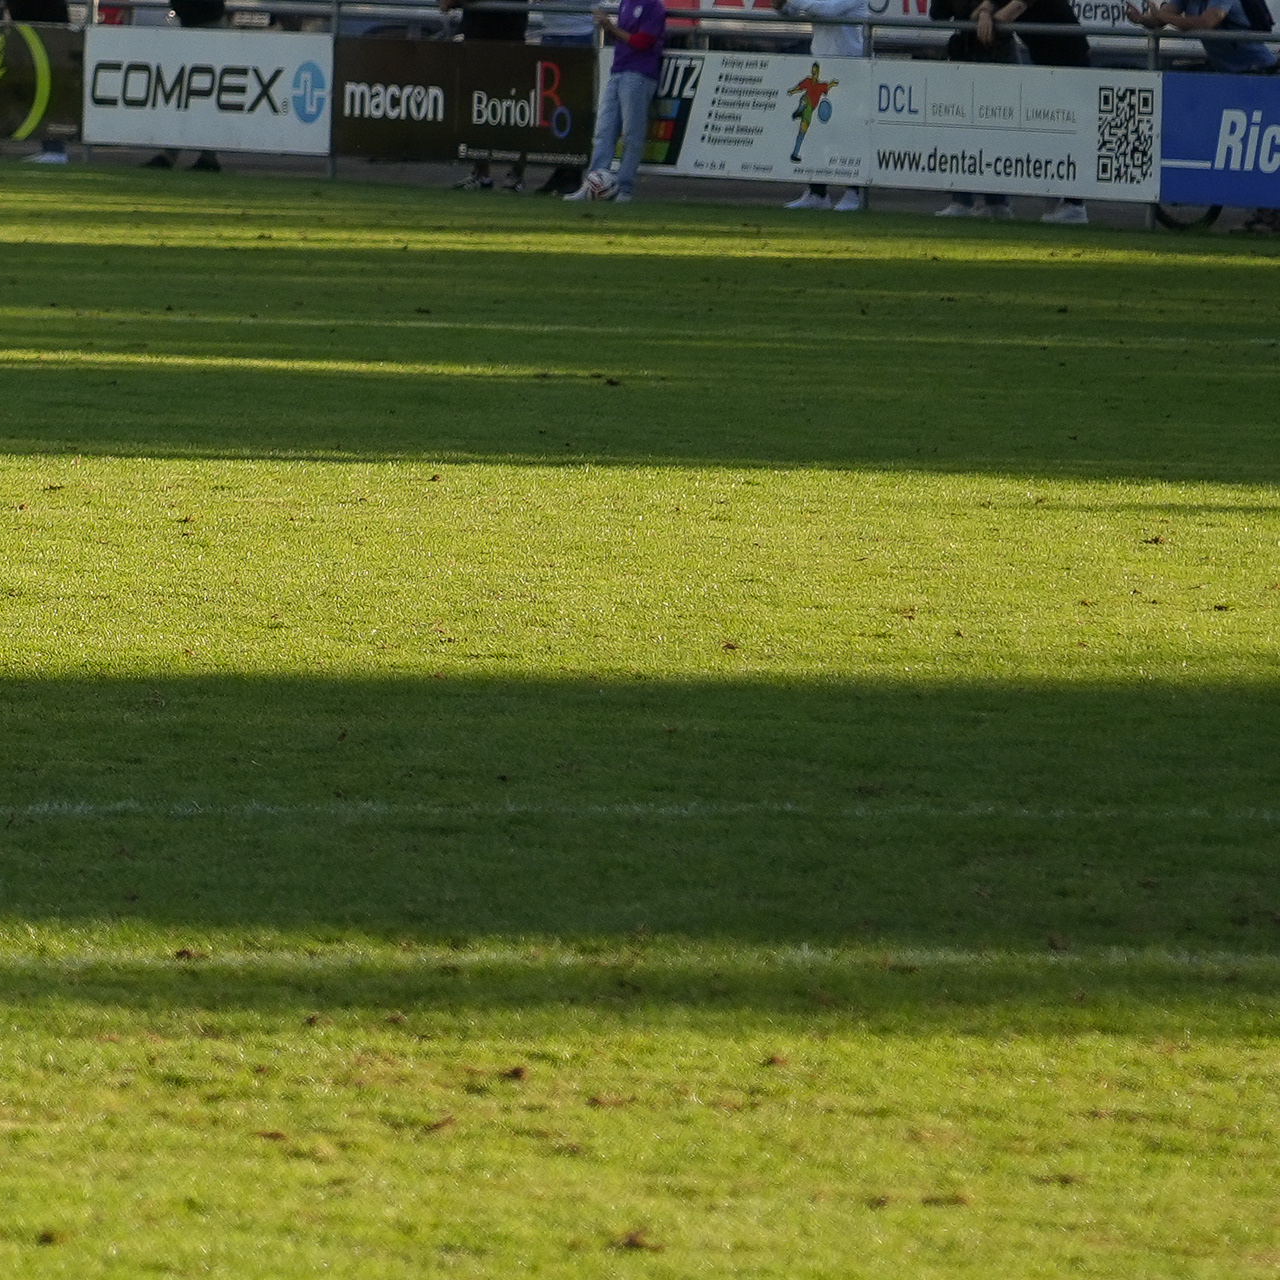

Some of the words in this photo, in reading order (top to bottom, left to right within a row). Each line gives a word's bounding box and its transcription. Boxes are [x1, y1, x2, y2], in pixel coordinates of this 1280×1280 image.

[92, 61, 286, 115] COMPEX
[343, 81, 445, 121] macron
[877, 83, 920, 115] DCL
[931, 102, 967, 118] DENTAL
[978, 104, 1015, 120] CENTER
[1026, 107, 1078, 124] LIMMATTAL
[876, 146, 1078, 182] www.dental-center.ch
